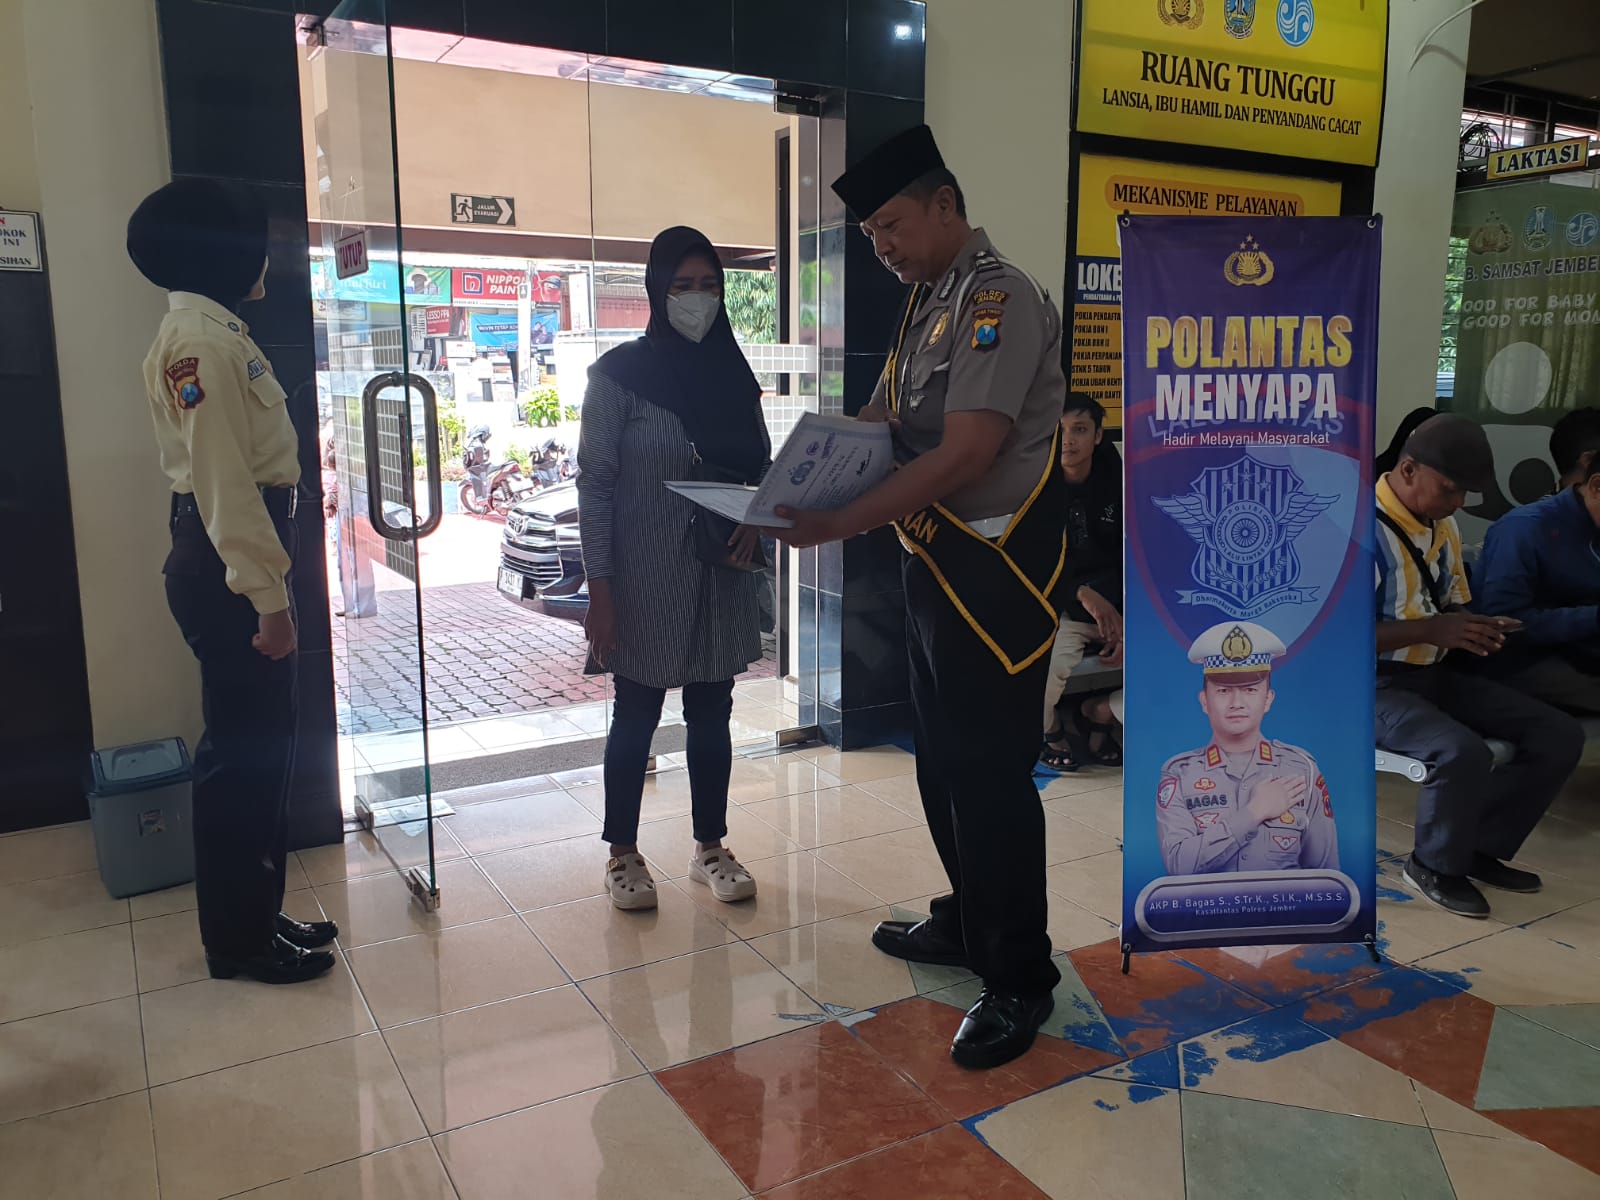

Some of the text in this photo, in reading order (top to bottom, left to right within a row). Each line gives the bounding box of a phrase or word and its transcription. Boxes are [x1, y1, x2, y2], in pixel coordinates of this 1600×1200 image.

[1140, 50, 1336, 106] RUANG TUNGGU
[1102, 88, 1362, 136] LANSIA, IBU HAMIL DAN PENYANDANG CACAT
[1495, 143, 1581, 174] LAKTASI
[1113, 183, 1297, 216] MEKANISME PELAYANAN
[1482, 260, 1542, 280] SAMSAT
[1545, 254, 1600, 275] JEMBE
[1505, 296, 1538, 311] FOR
[1546, 293, 1596, 309] BABY
[1463, 314, 1511, 330] GOOD
[1520, 312, 1554, 328] FOR
[1146, 315, 1353, 368] POLANTAS
[168, 358, 196, 375] POLDA
[1155, 373, 1338, 421] MENYAPA
[1163, 431, 1330, 449] Hadir Melayani Masyarakat
[1186, 794, 1228, 810] BAGAS
[1149, 900, 1169, 912] AKP
[1172, 899, 1182, 909] B.
[1185, 898, 1215, 909] Bagas
[1241, 905, 1267, 913] Polres
[1268, 904, 1296, 912] Jember
